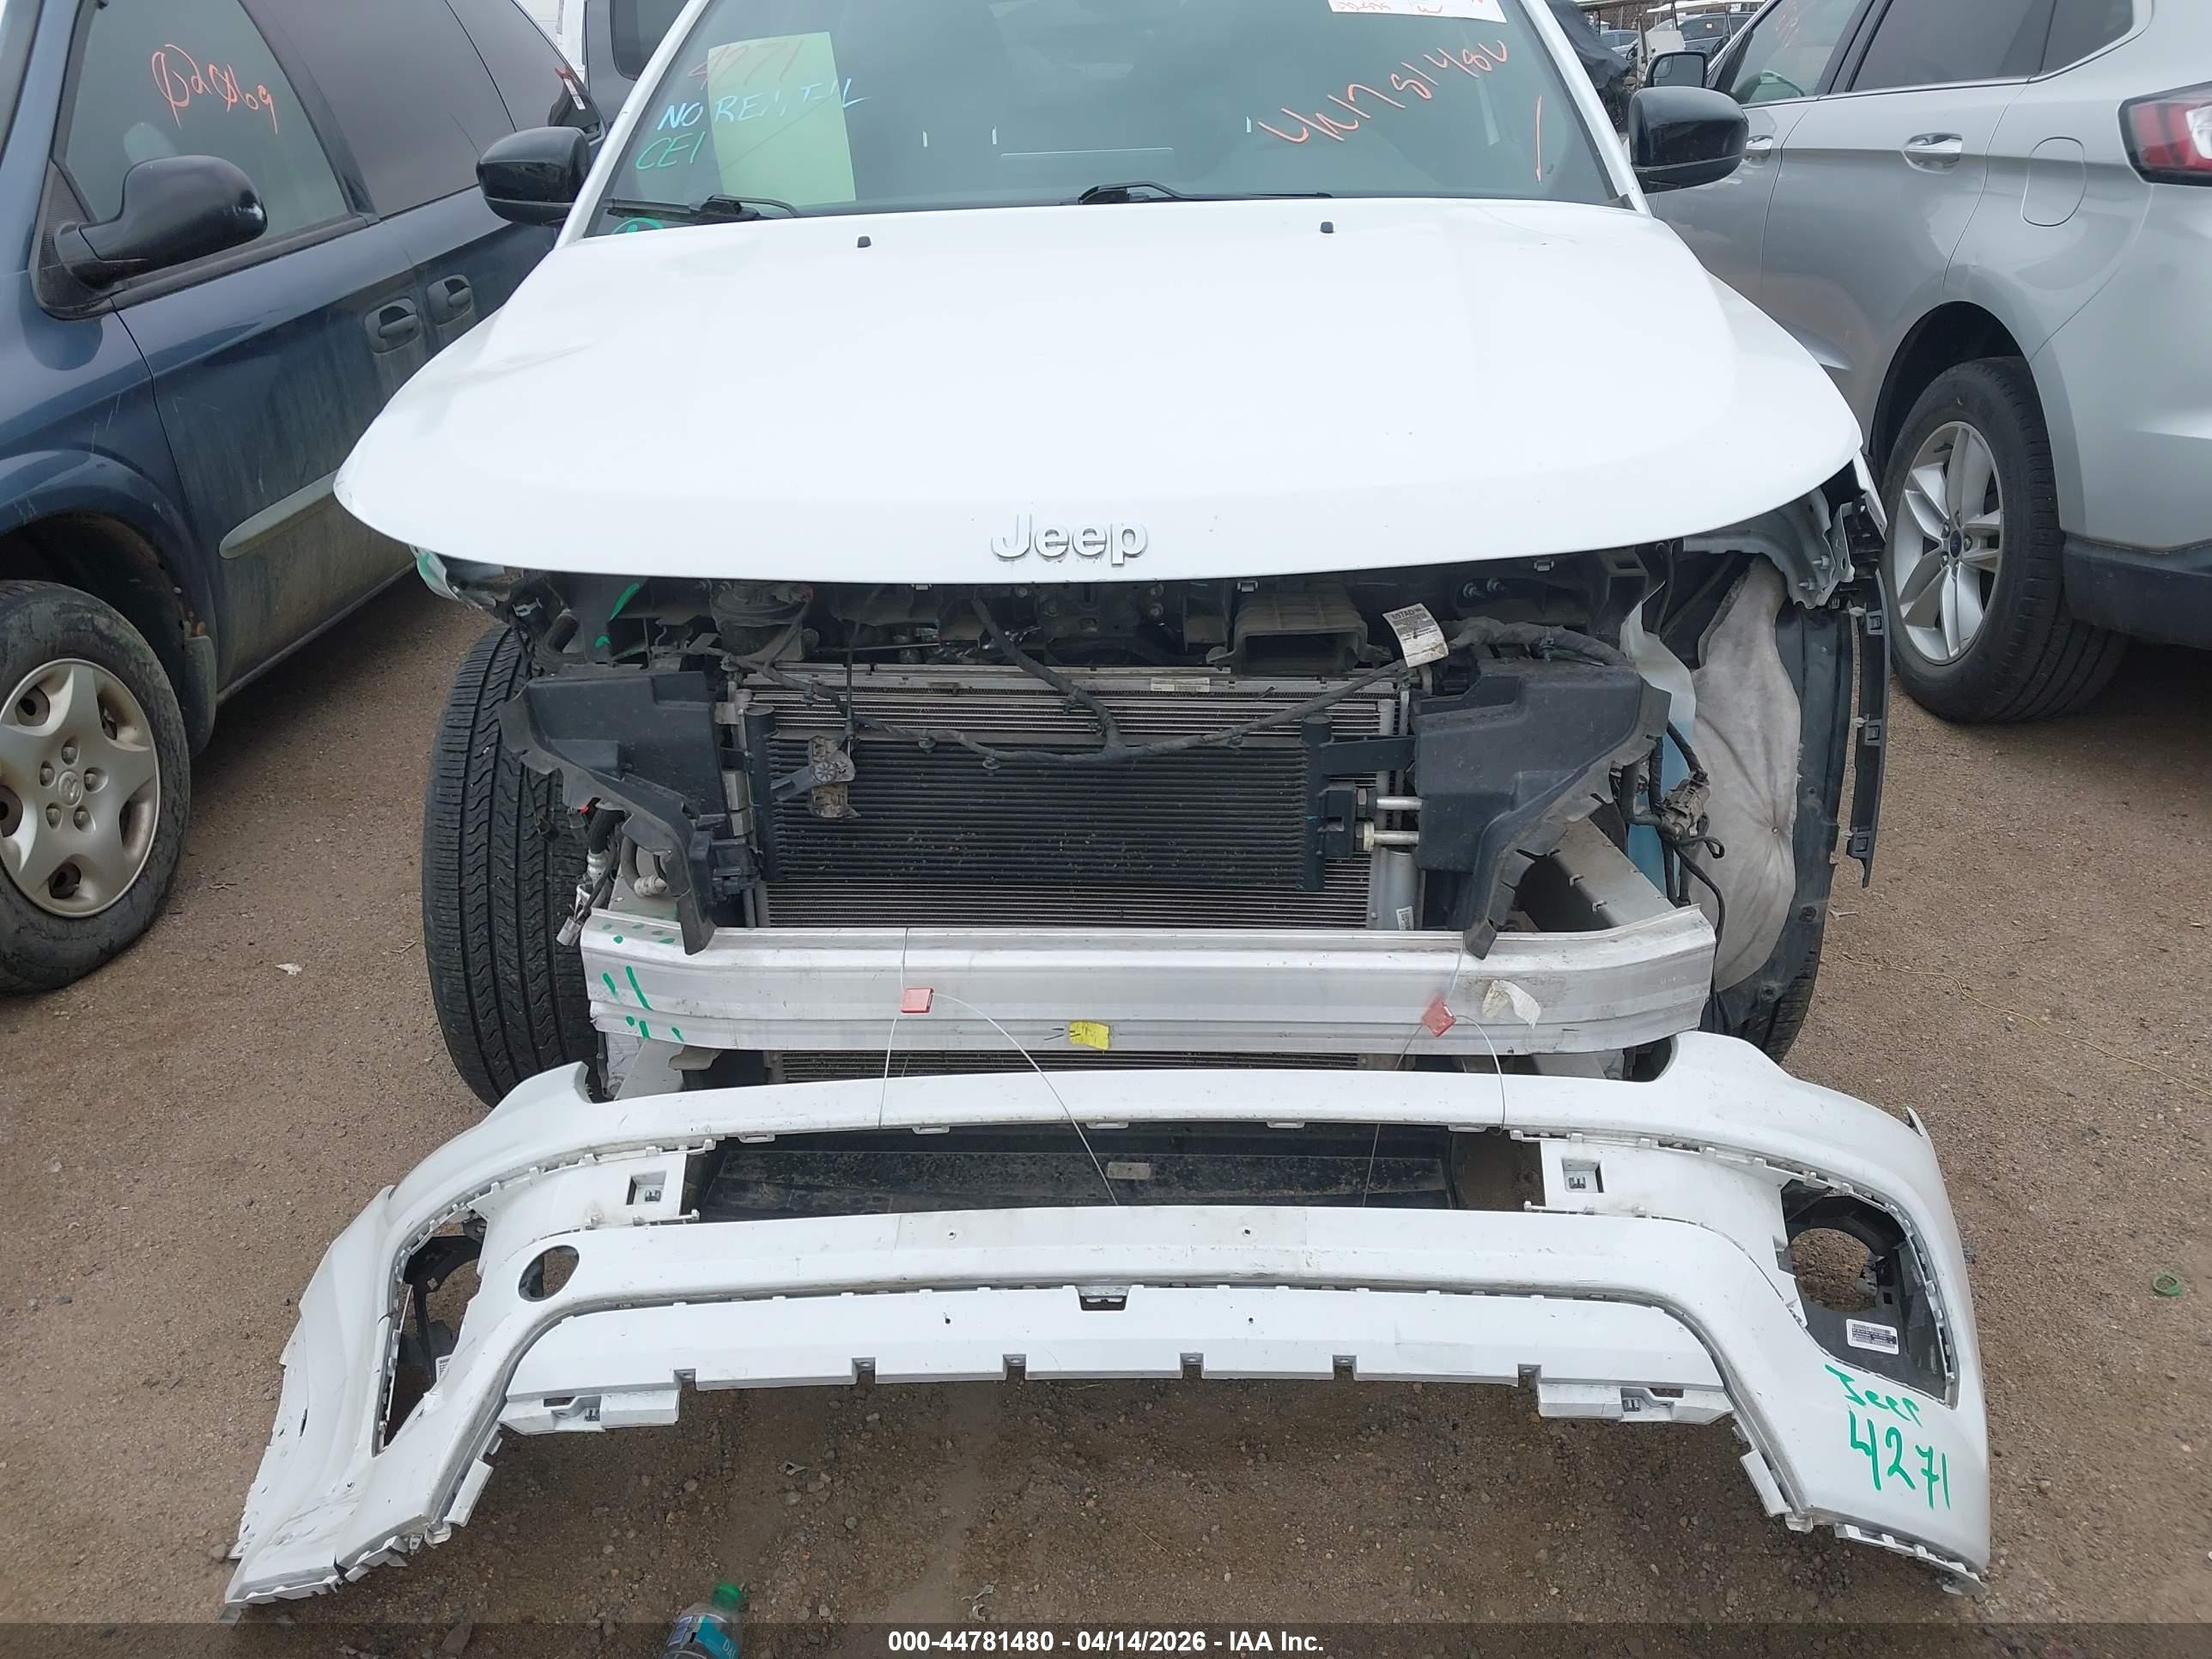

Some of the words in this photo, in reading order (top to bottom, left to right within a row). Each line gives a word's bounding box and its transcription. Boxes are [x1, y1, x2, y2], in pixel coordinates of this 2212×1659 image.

[657, 102, 703, 131] NO
[991, 514, 1148, 567] Jeep
[1847, 1405, 1951, 1510] 4271
